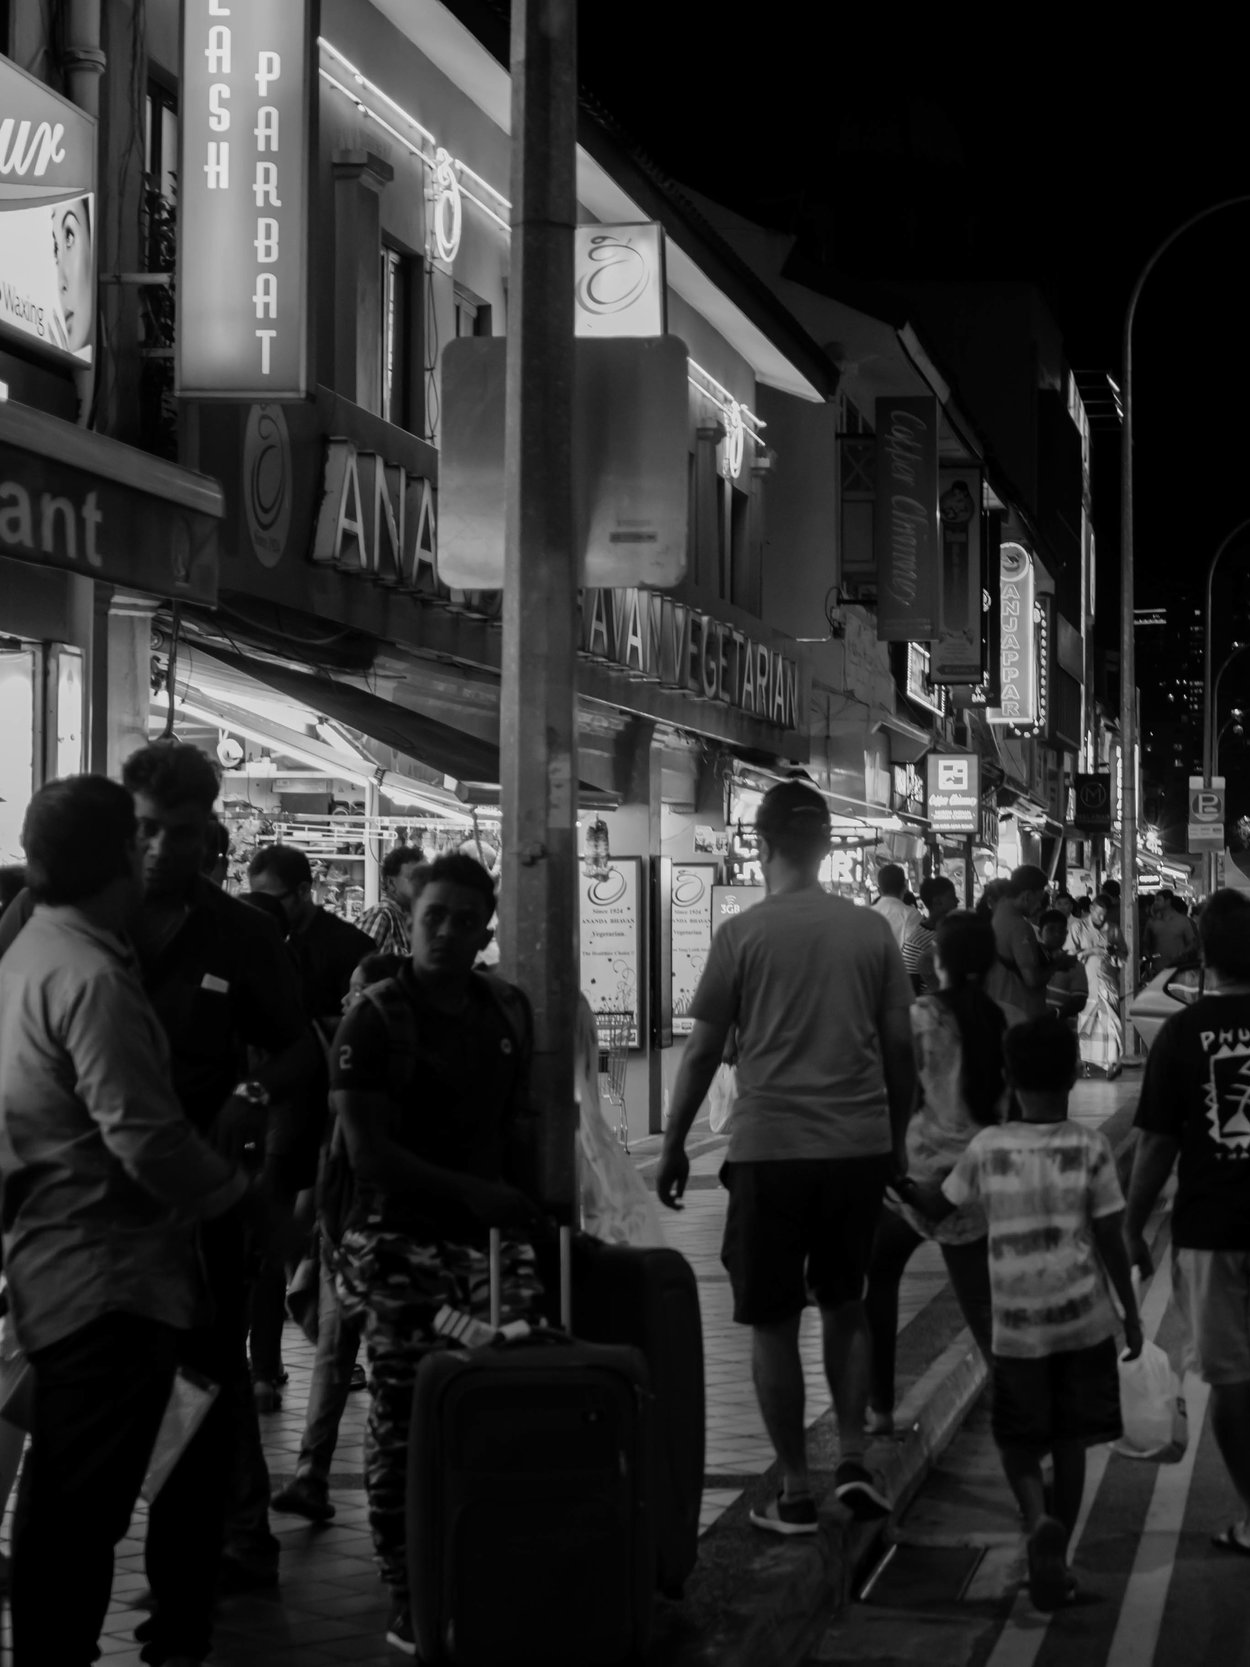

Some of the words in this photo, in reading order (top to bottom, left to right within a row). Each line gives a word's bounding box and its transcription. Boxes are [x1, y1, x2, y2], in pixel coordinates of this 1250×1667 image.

[252, 51, 282, 374] PARBAT
[3, 281, 45, 337] Waxing
[0, 481, 103, 567] ant
[664, 602, 799, 729] VEGETARIAN
[1000, 583, 1021, 716] ANJAPPAR
